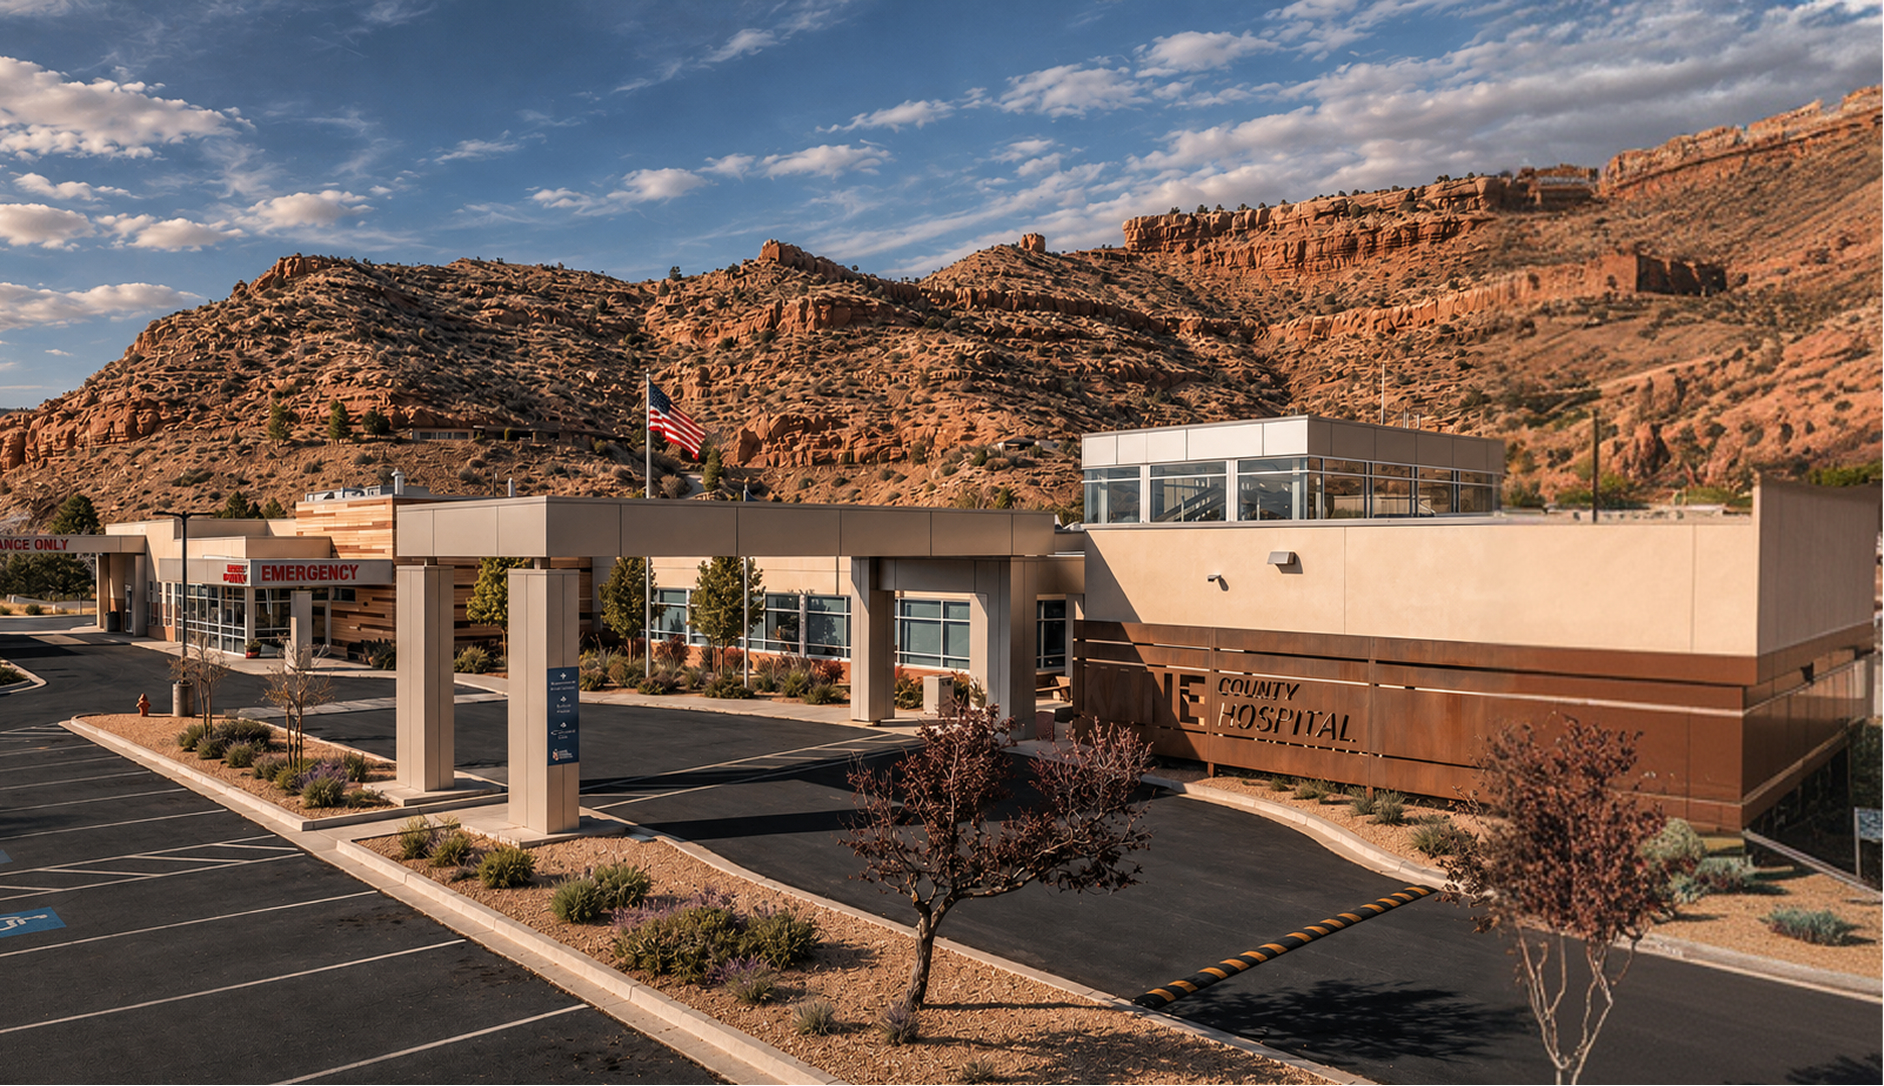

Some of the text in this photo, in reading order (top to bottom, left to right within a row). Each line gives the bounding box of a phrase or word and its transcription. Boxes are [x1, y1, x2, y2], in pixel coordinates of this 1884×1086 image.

[34, 539, 69, 550] ONLY
[261, 564, 359, 581] EMERGENCY
[1218, 677, 1300, 701] COUNTY
